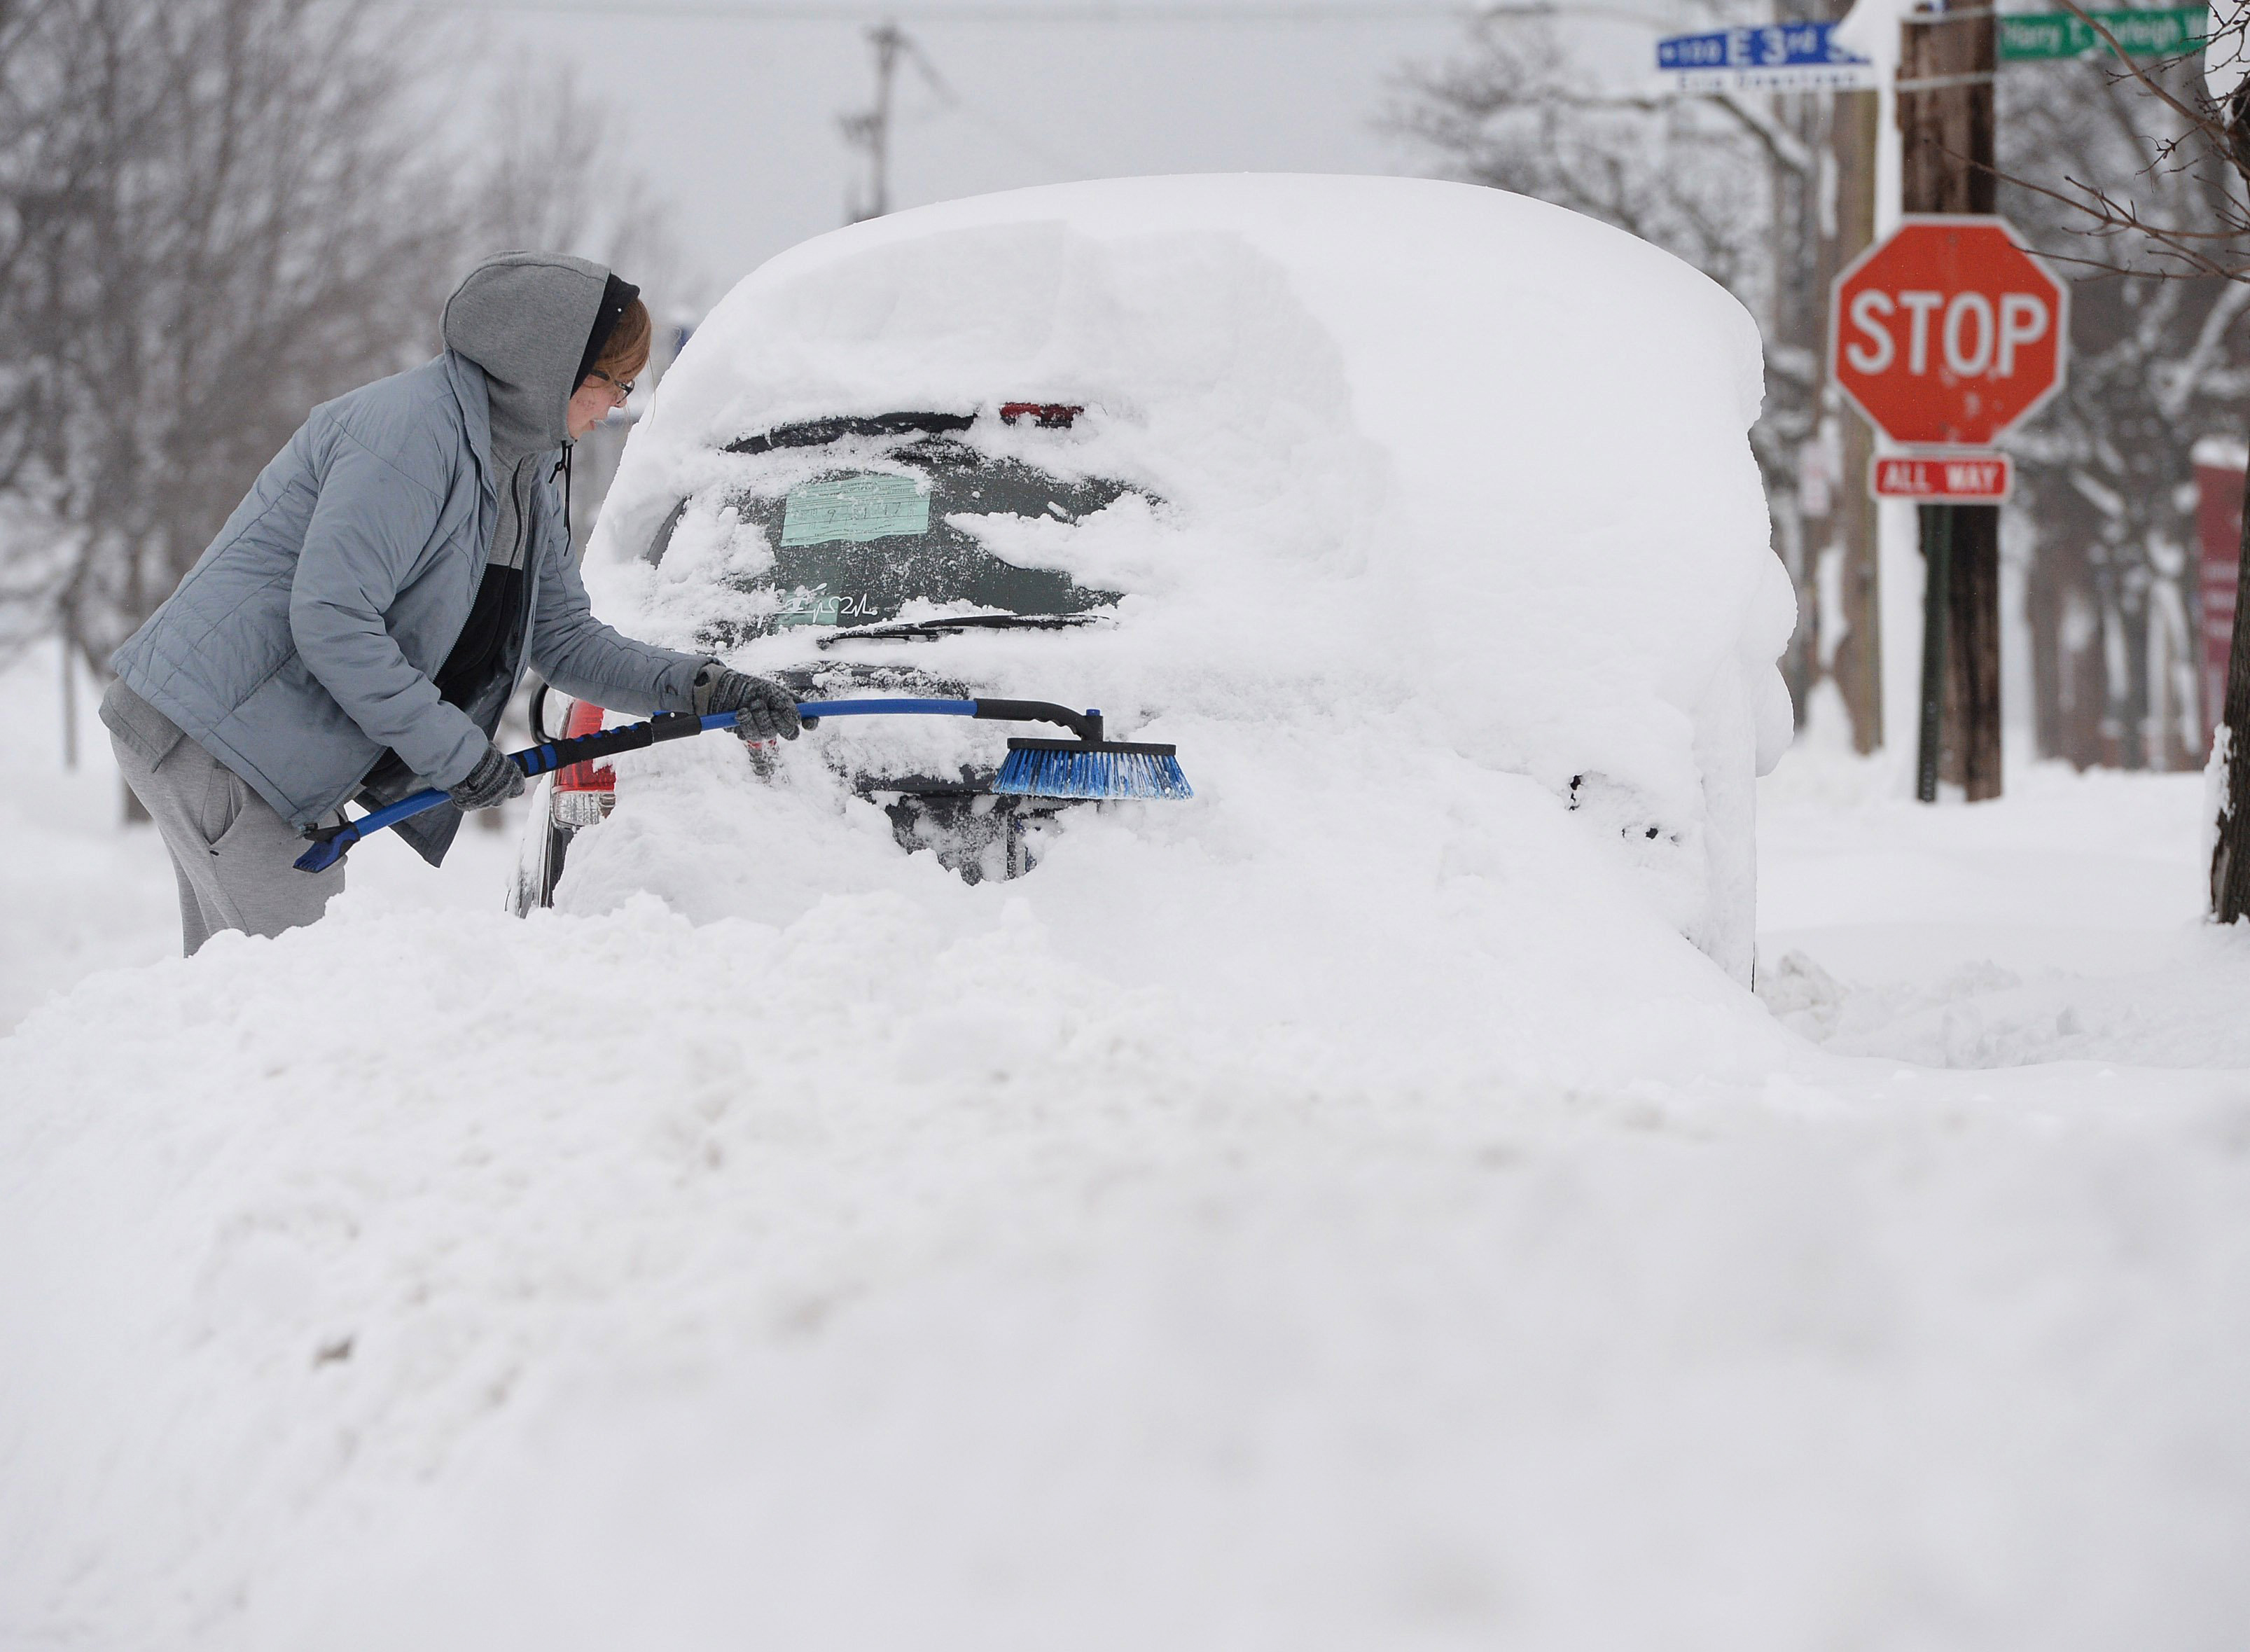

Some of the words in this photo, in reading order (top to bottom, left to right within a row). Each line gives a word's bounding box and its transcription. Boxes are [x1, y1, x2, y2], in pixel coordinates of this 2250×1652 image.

[1727, 28, 1753, 66] E
[1762, 27, 1818, 65] 3rd
[1846, 289, 2049, 378] STOP
[1882, 463, 1930, 492] ALL
[1944, 463, 2001, 492] WAY
